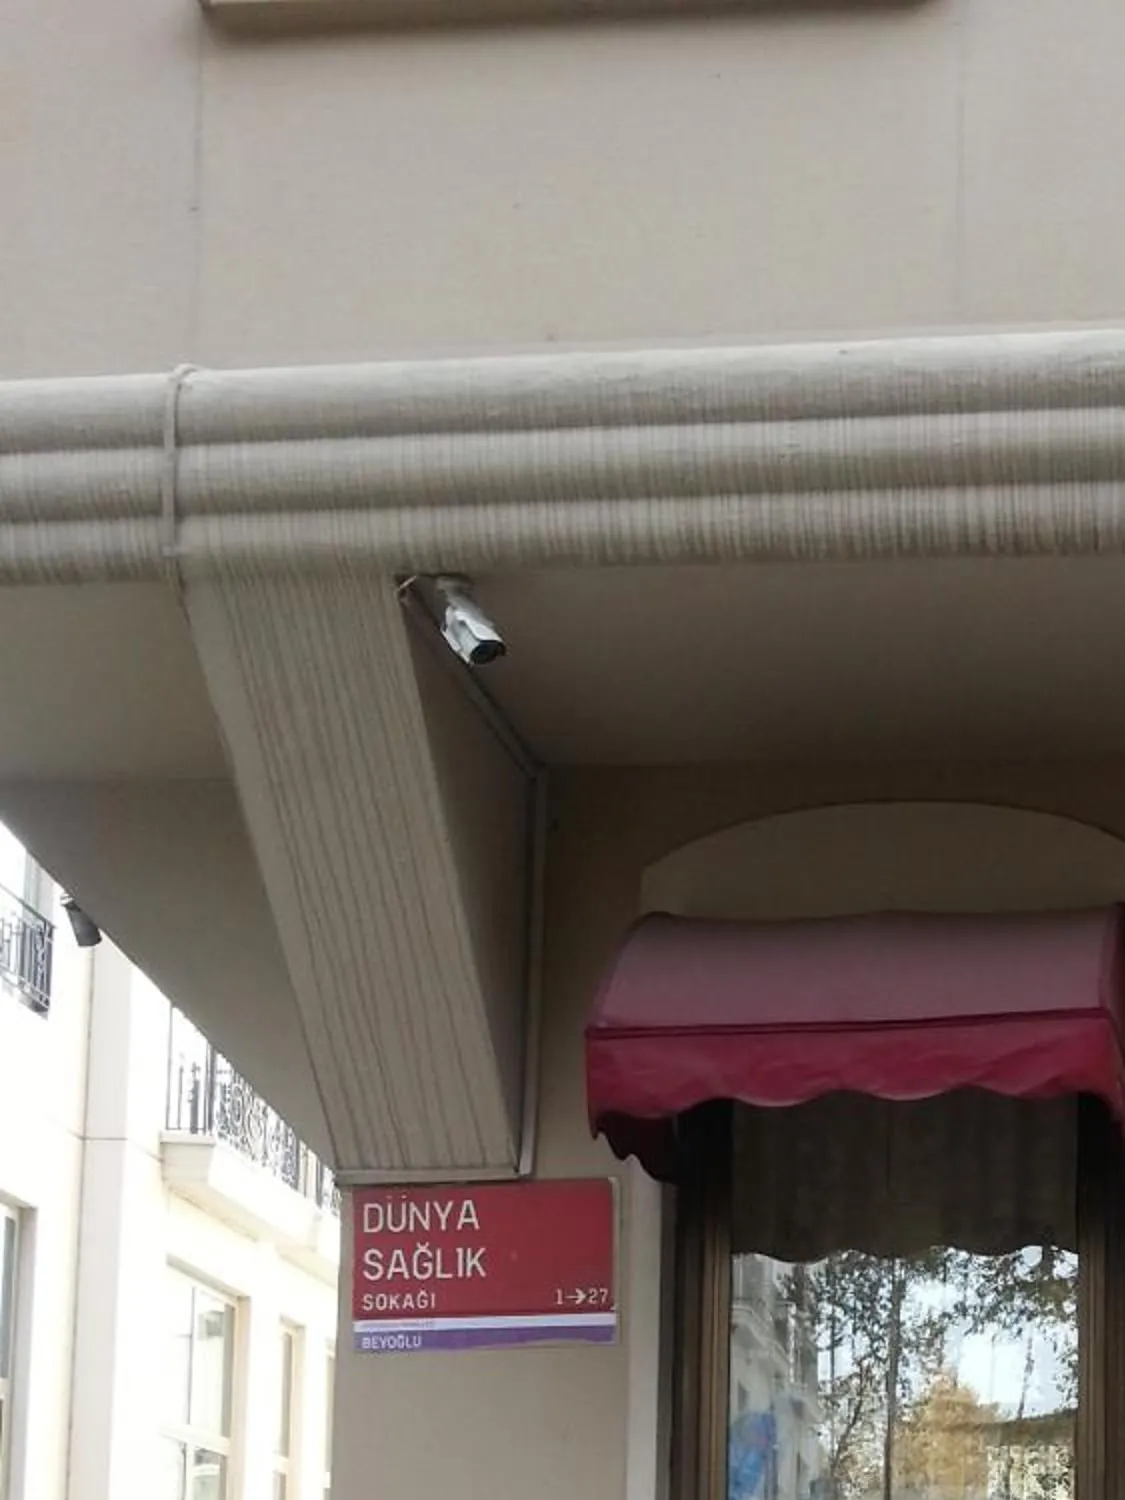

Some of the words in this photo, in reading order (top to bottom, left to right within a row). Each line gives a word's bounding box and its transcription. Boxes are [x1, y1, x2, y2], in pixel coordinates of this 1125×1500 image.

[362, 1194, 480, 1234] DÜNYA
[362, 1242, 487, 1281] SAĞLIK
[361, 1290, 436, 1311] SOKAĞI
[361, 1335, 422, 1350] BEYOĞLU
